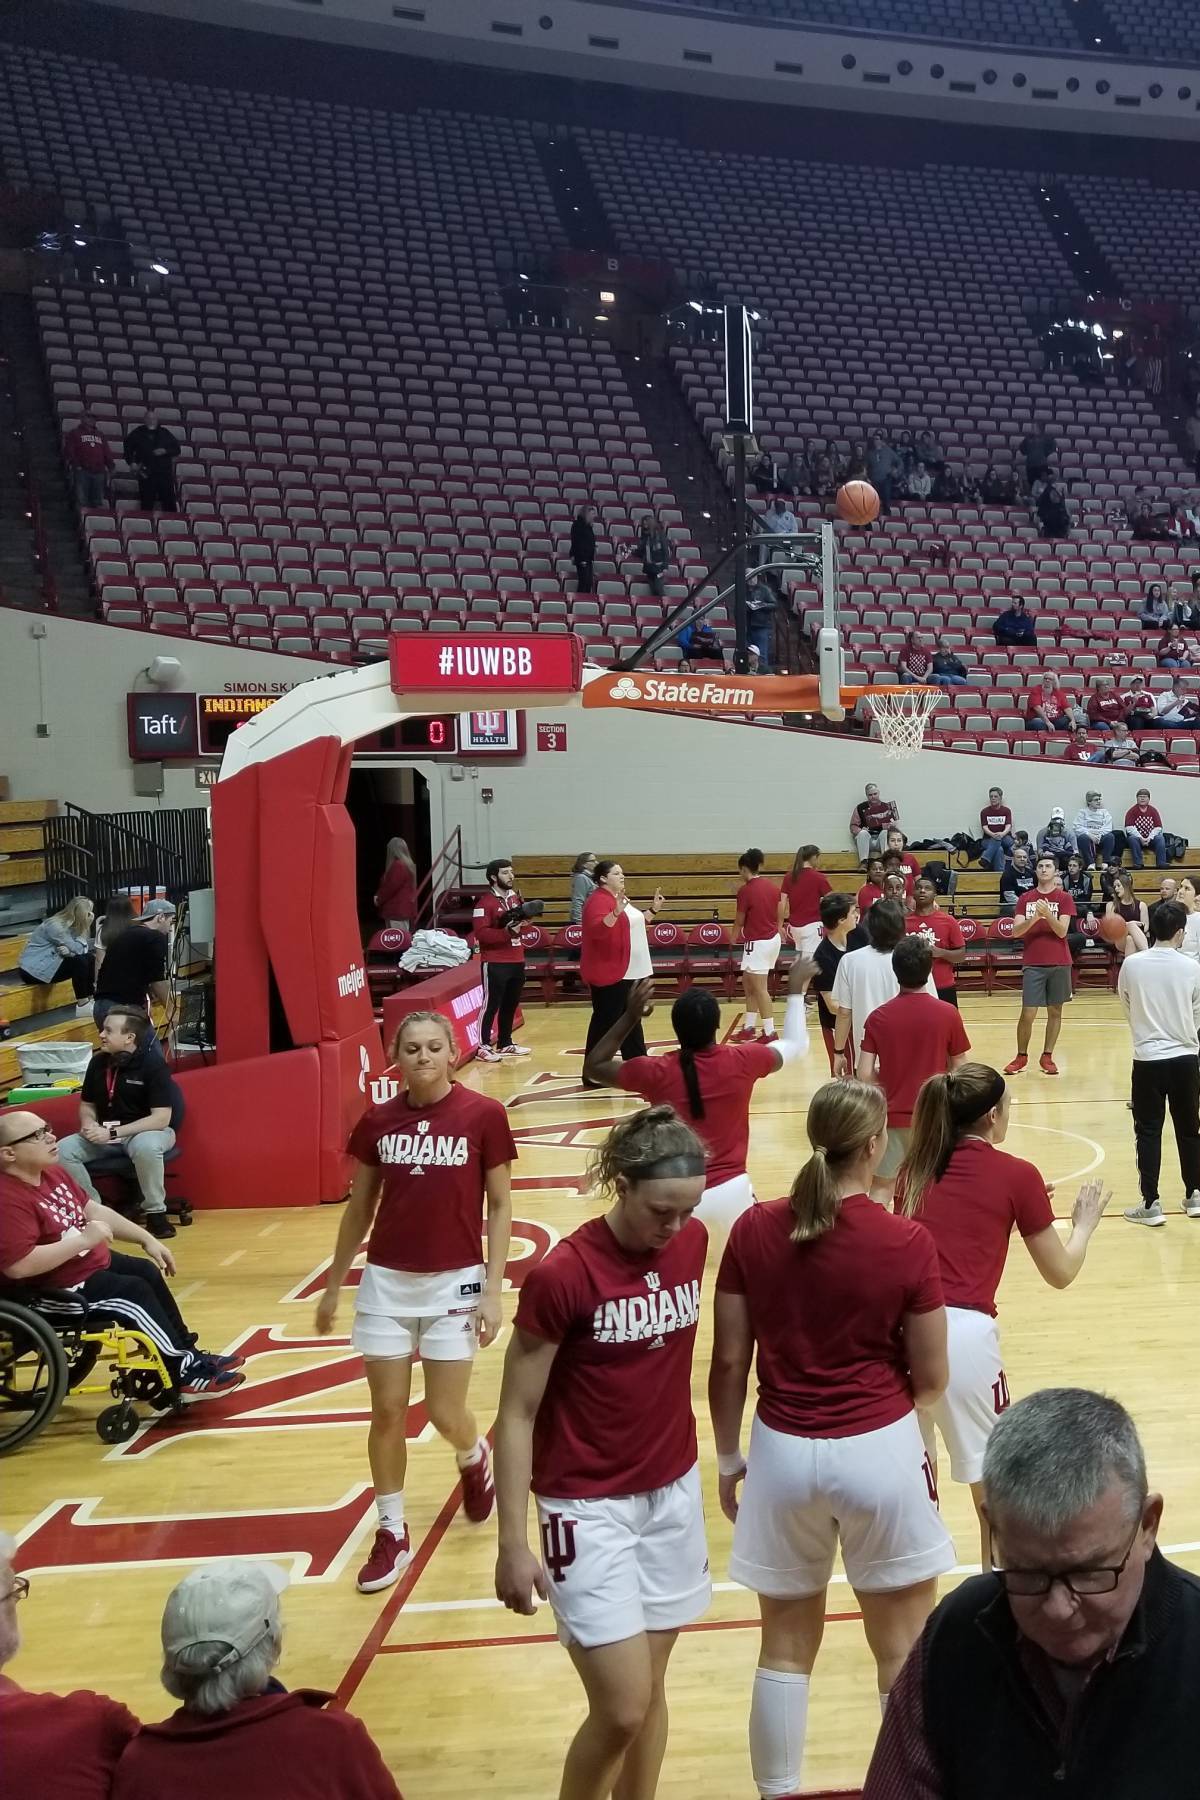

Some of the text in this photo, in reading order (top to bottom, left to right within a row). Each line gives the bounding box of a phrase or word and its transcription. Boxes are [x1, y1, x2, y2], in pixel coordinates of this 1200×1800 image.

[607, 258, 619, 271] B
[438, 646, 533, 676] #IUWBB
[223, 682, 267, 693] SIMON
[429, 721, 444, 744] 0
[538, 725, 565, 733] SECTION
[547, 733, 557, 749] 3
[337, 964, 365, 998] meijer
[376, 1134, 468, 1166] INDIANA
